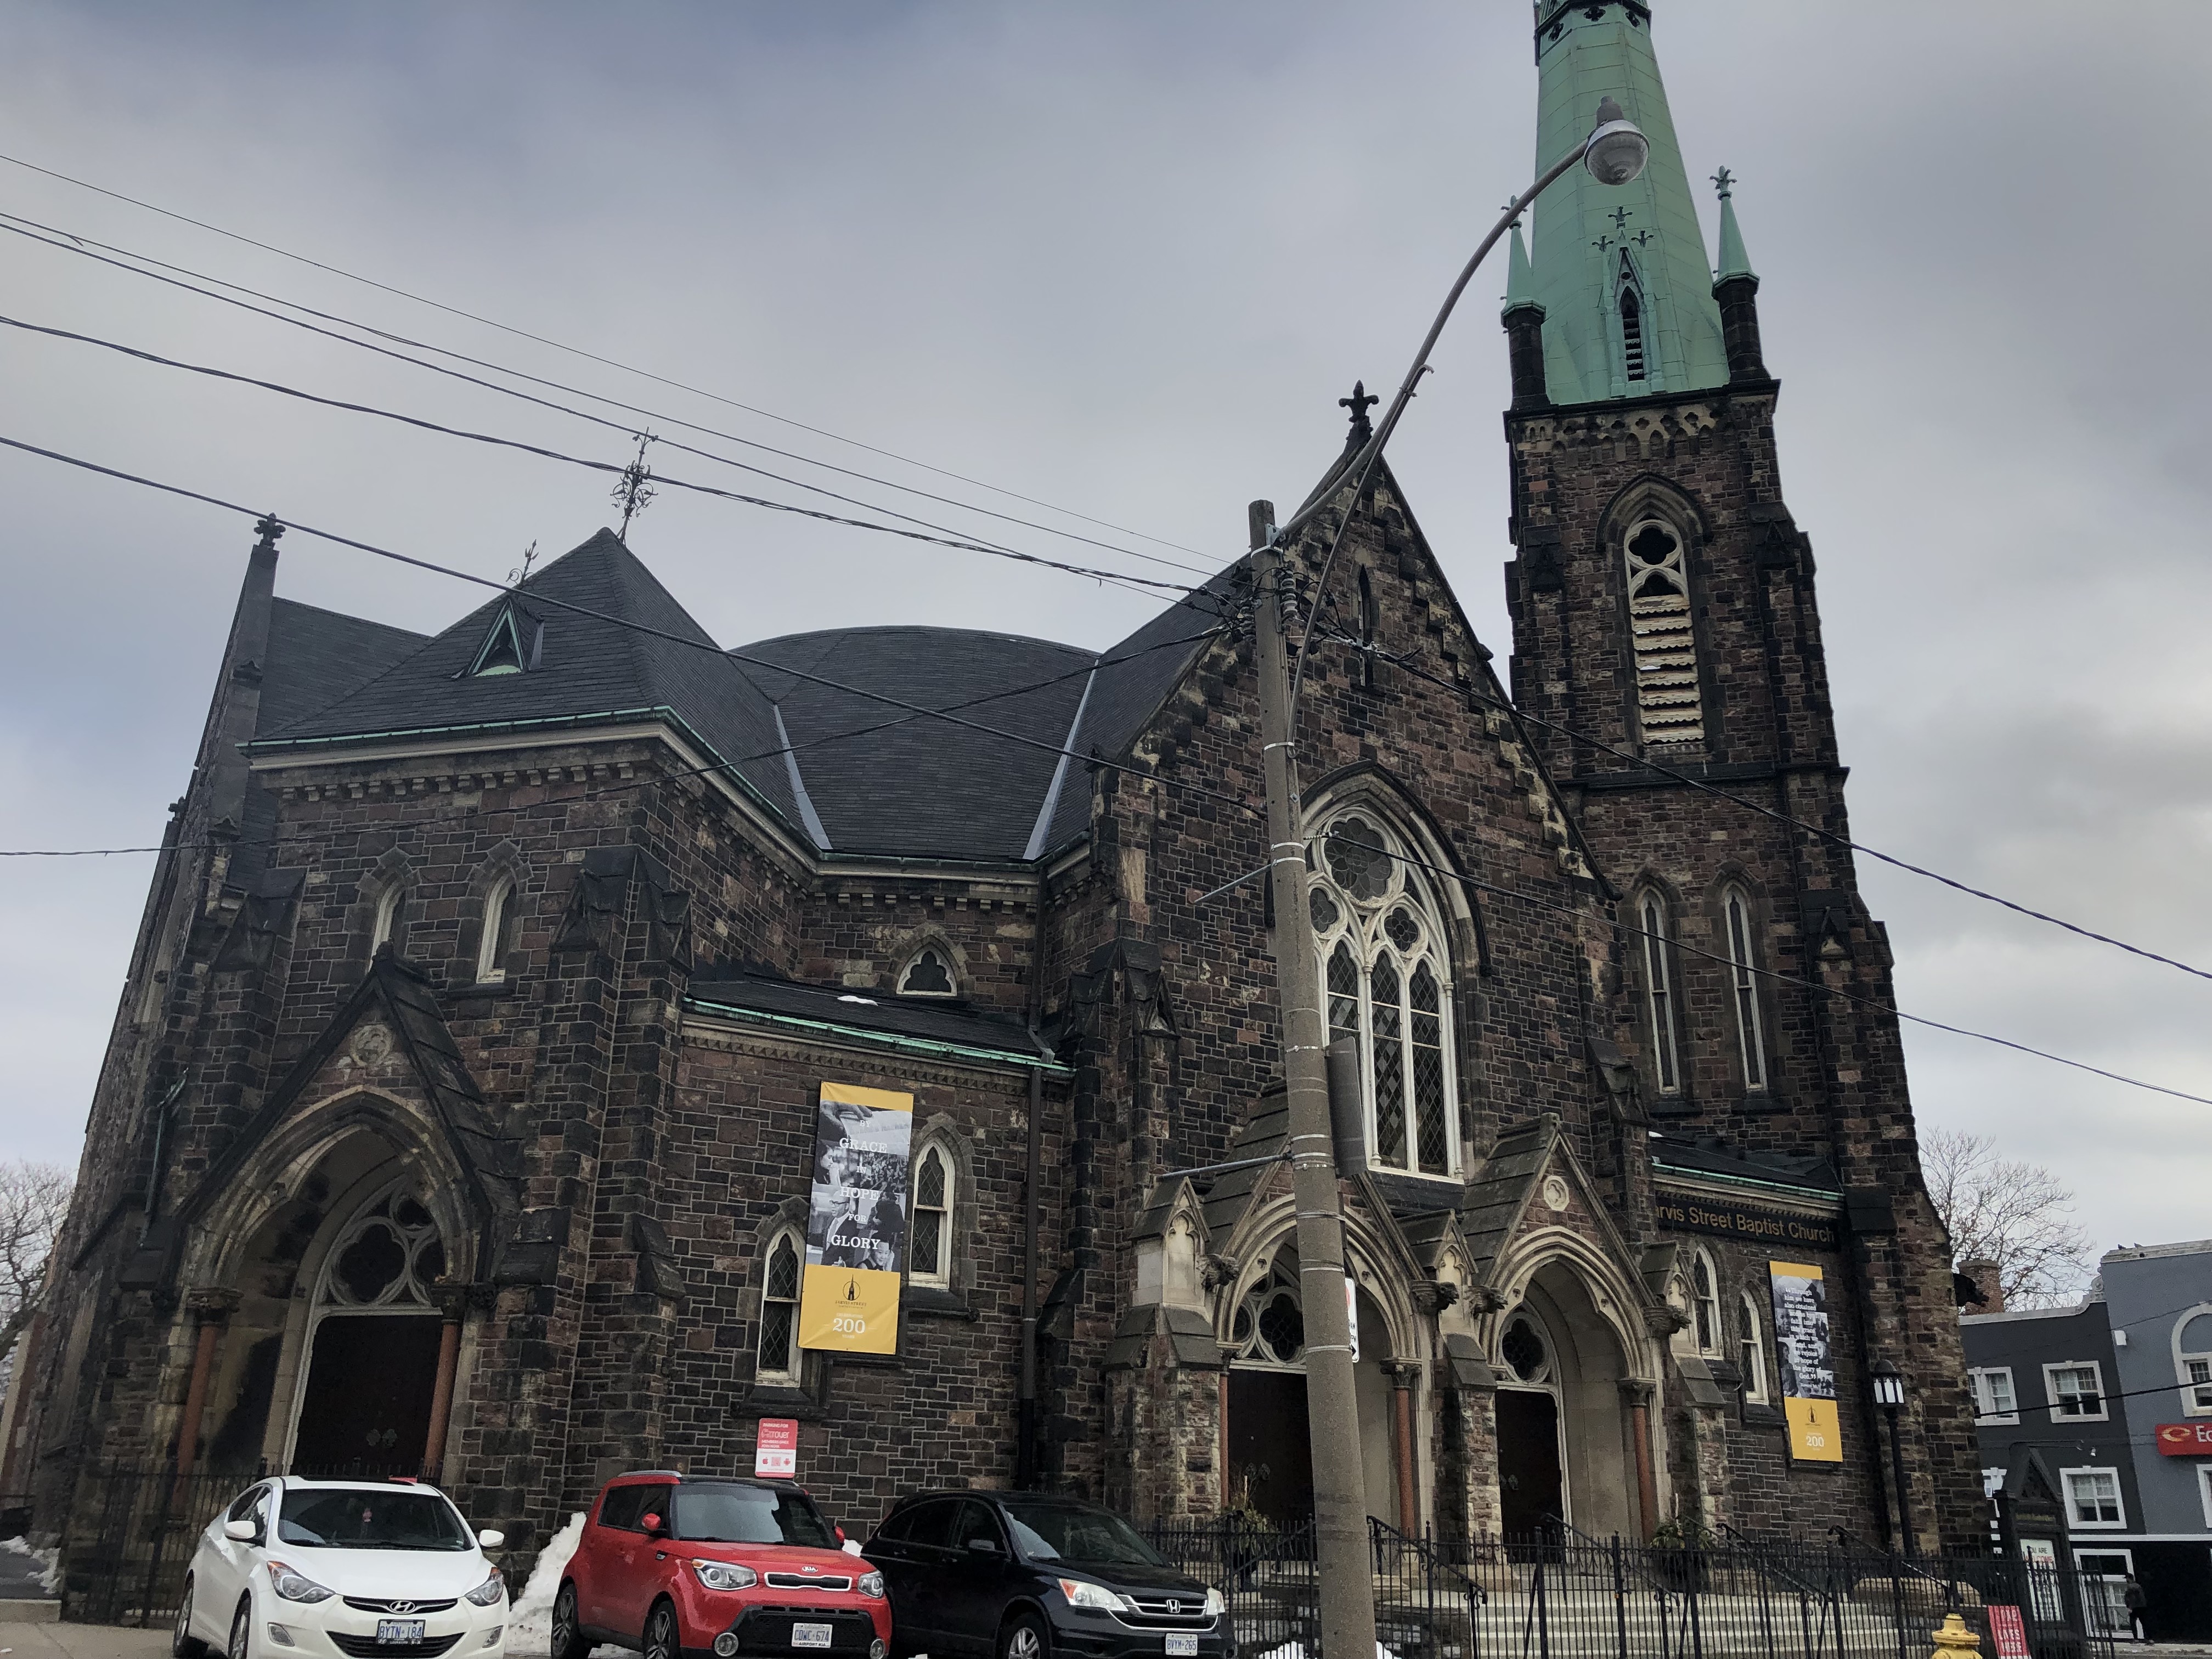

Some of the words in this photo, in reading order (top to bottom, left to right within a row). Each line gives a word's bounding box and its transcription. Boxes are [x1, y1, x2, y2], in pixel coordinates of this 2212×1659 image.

[839, 1137, 887, 1153] GRACE
[840, 1186, 880, 1200] HOPE
[848, 1214, 867, 1222] FOR
[1689, 1207, 1733, 1229] Street
[1736, 1214, 1785, 1236] Baptist
[1788, 1222, 1835, 1243] Church
[831, 1234, 881, 1250] GLORY
[833, 1318, 865, 1334] 200
[1806, 1436, 1824, 1447] 200
[816, 1630, 830, 1642] 674
[1185, 1639, 1197, 1650] 265
